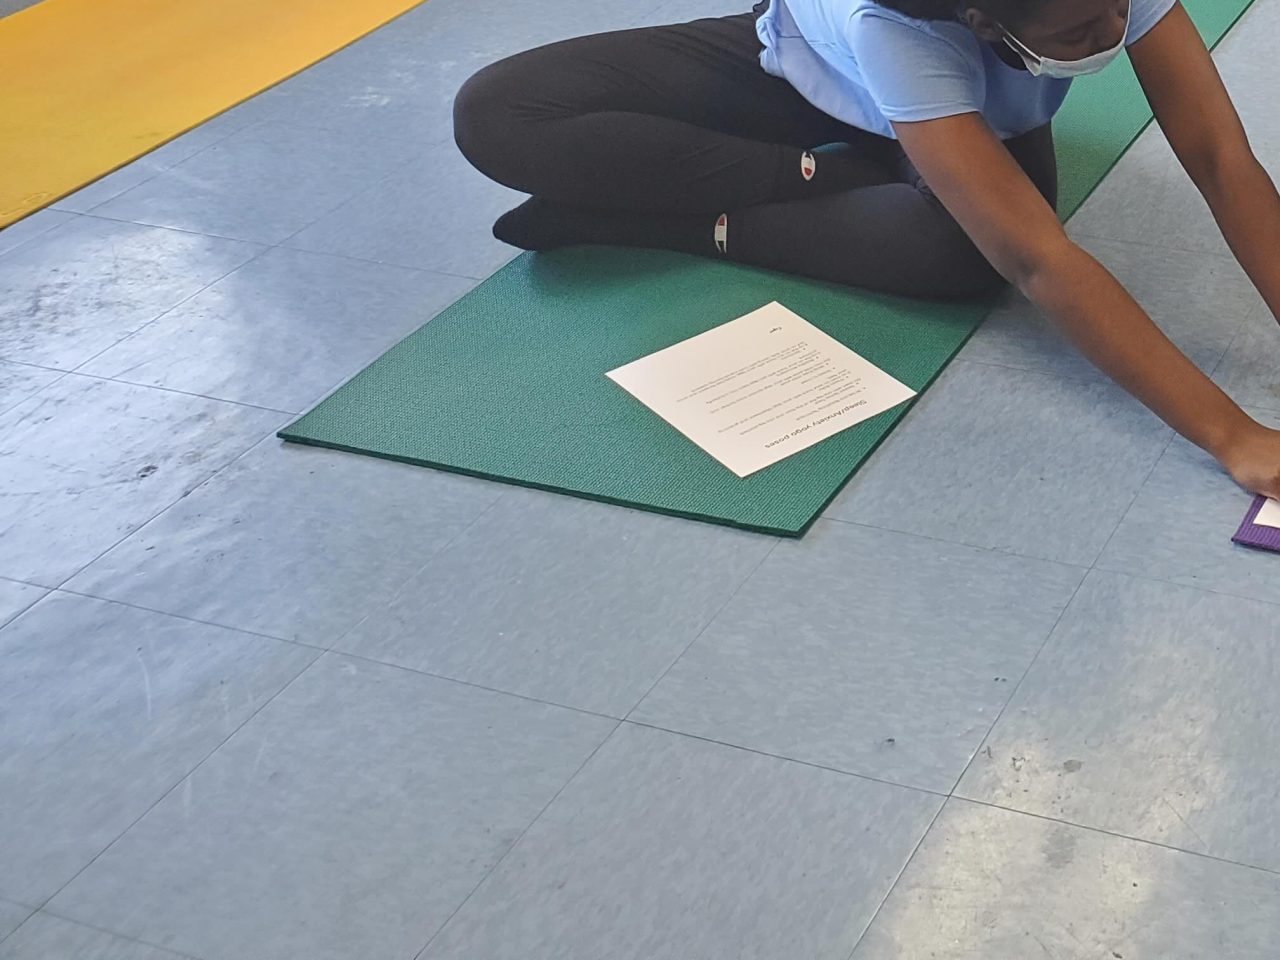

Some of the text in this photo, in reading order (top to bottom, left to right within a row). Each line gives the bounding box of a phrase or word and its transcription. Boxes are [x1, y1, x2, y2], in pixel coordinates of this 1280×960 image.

[812, 399, 868, 427] Sleep/Anxiety
[790, 424, 812, 437] yoga
[764, 434, 790, 449] poses
